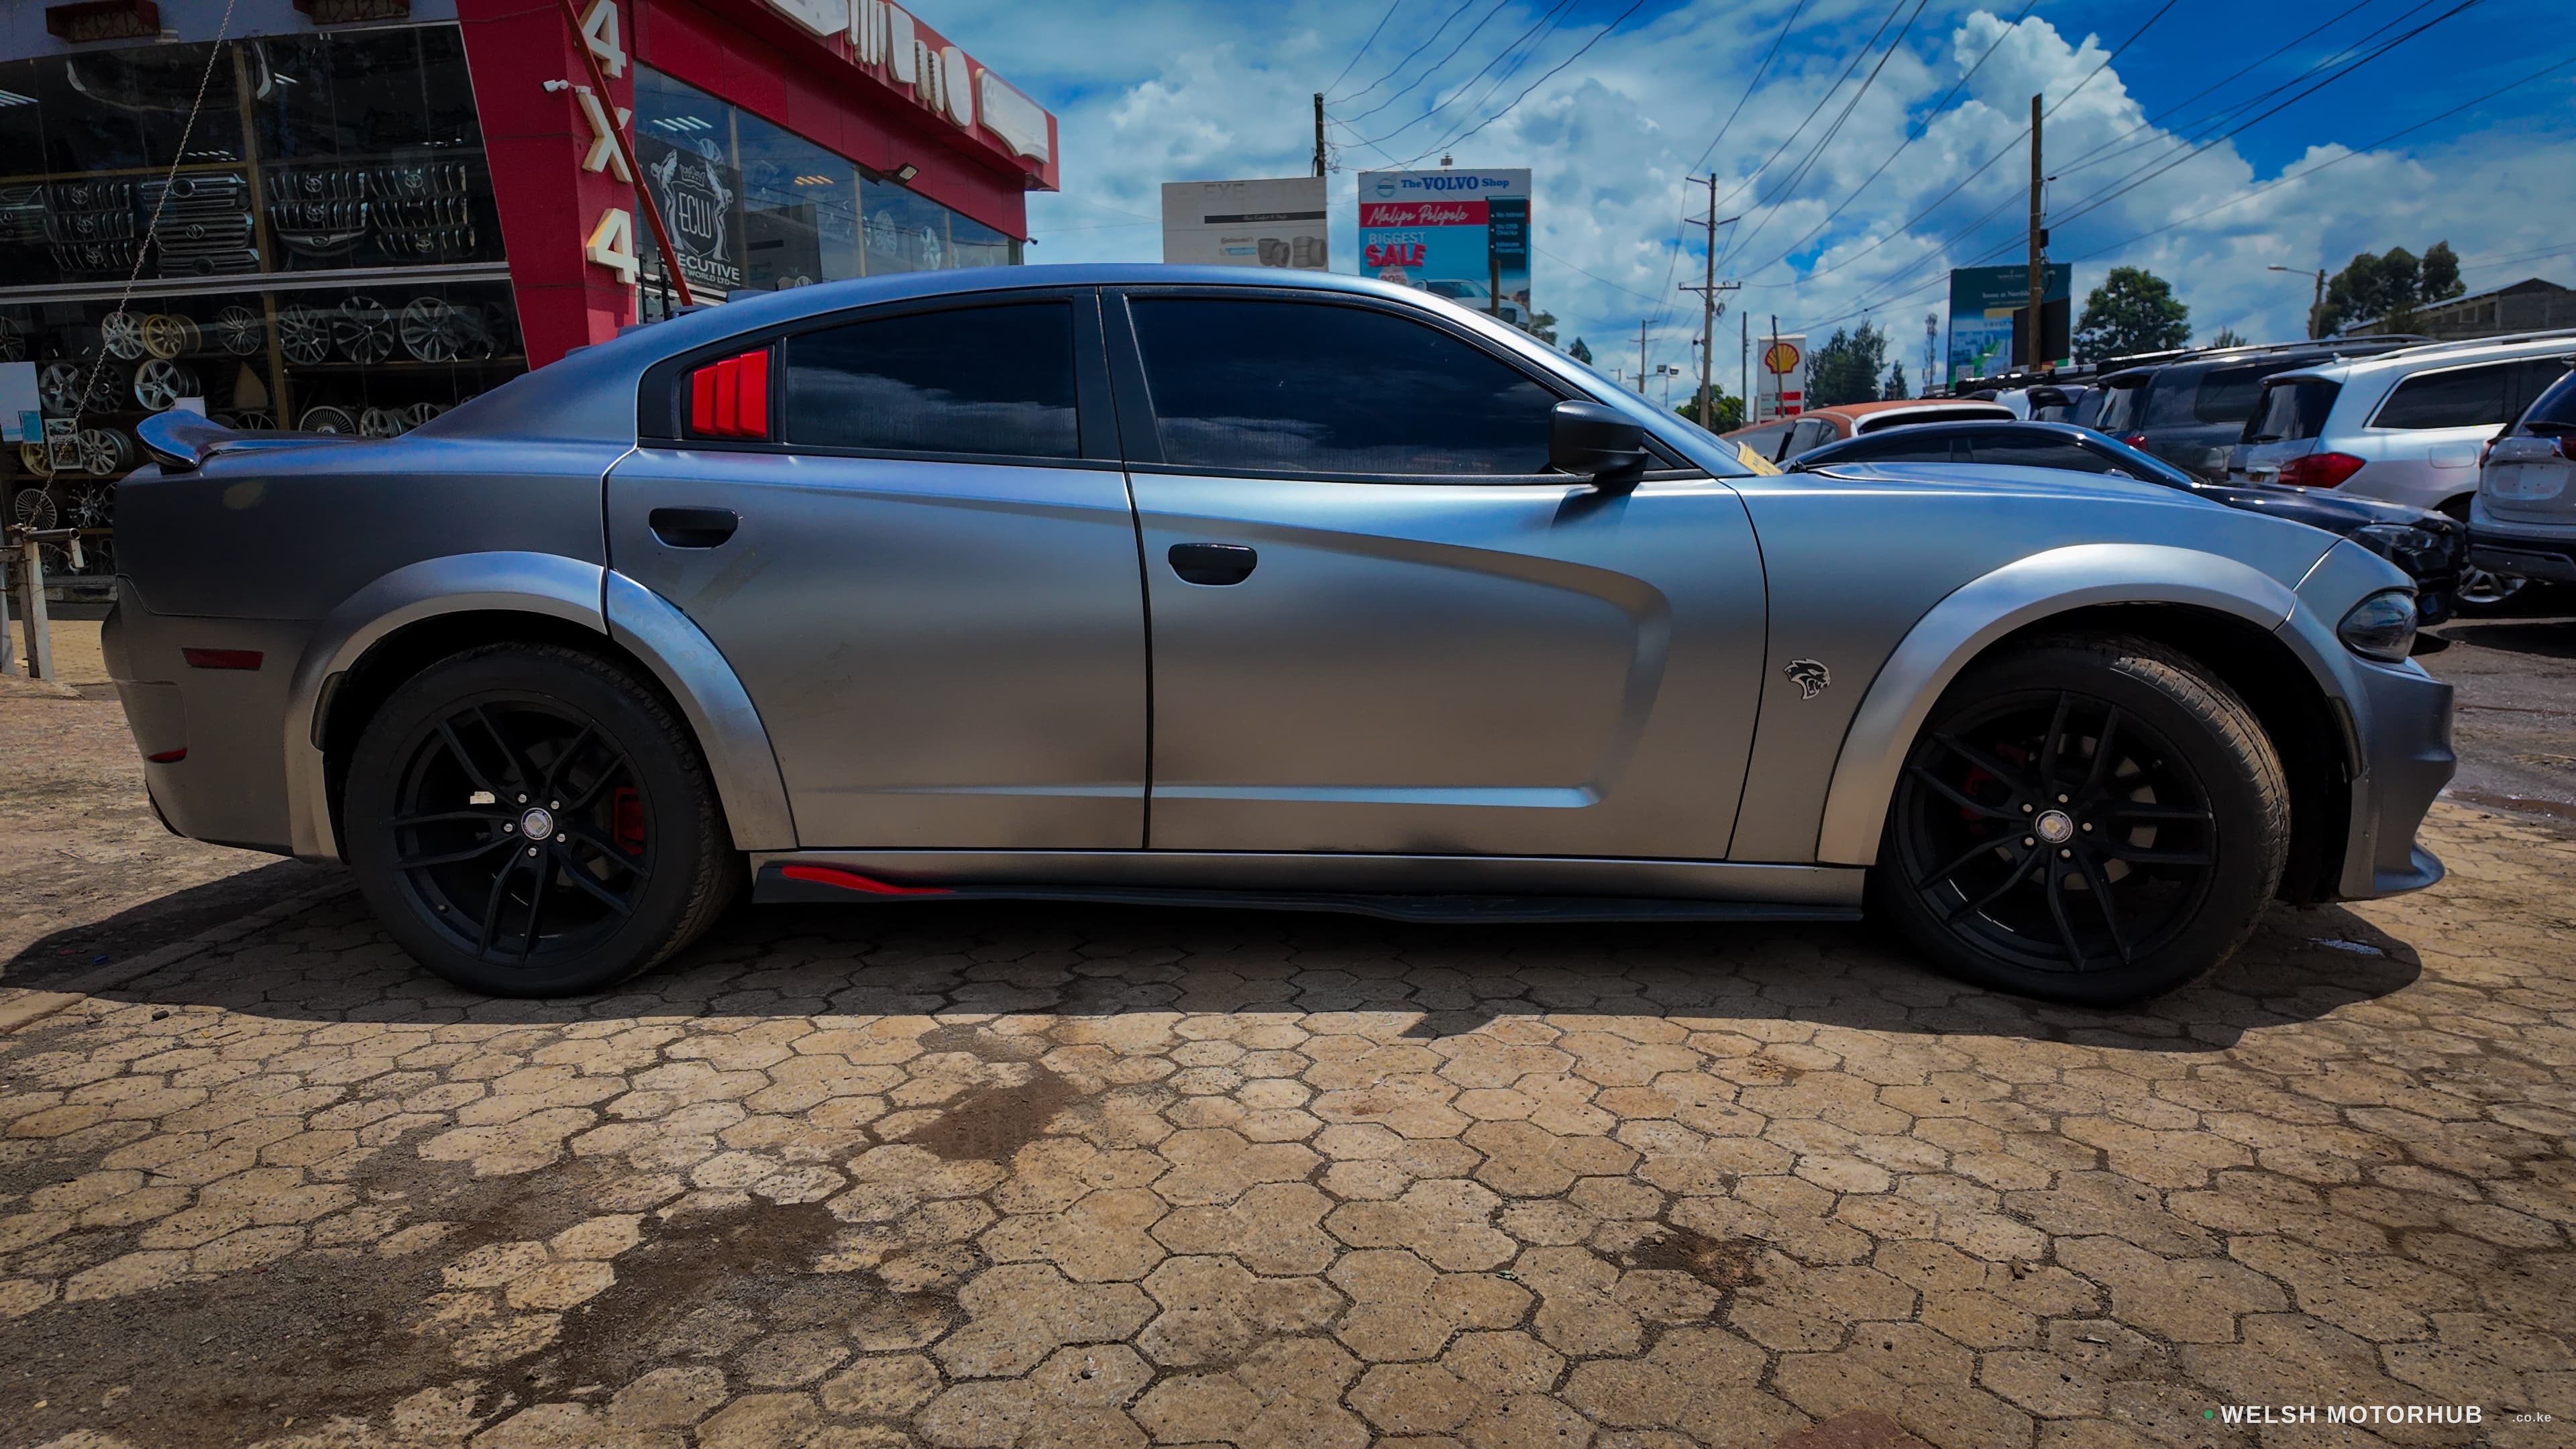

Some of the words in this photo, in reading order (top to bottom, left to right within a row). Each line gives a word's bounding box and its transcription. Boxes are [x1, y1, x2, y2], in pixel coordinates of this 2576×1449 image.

[1401, 179, 1421, 189] The
[1422, 176, 1479, 191] VOLVO
[1481, 178, 1509, 189] Shop
[678, 192, 712, 239] ECW
[1368, 231, 1426, 244] BIGGEST
[1364, 244, 1428, 267] SALE
[676, 252, 741, 280] ECUTIVE
[688, 270, 716, 282] WORLD
[717, 276, 731, 286] LTD
